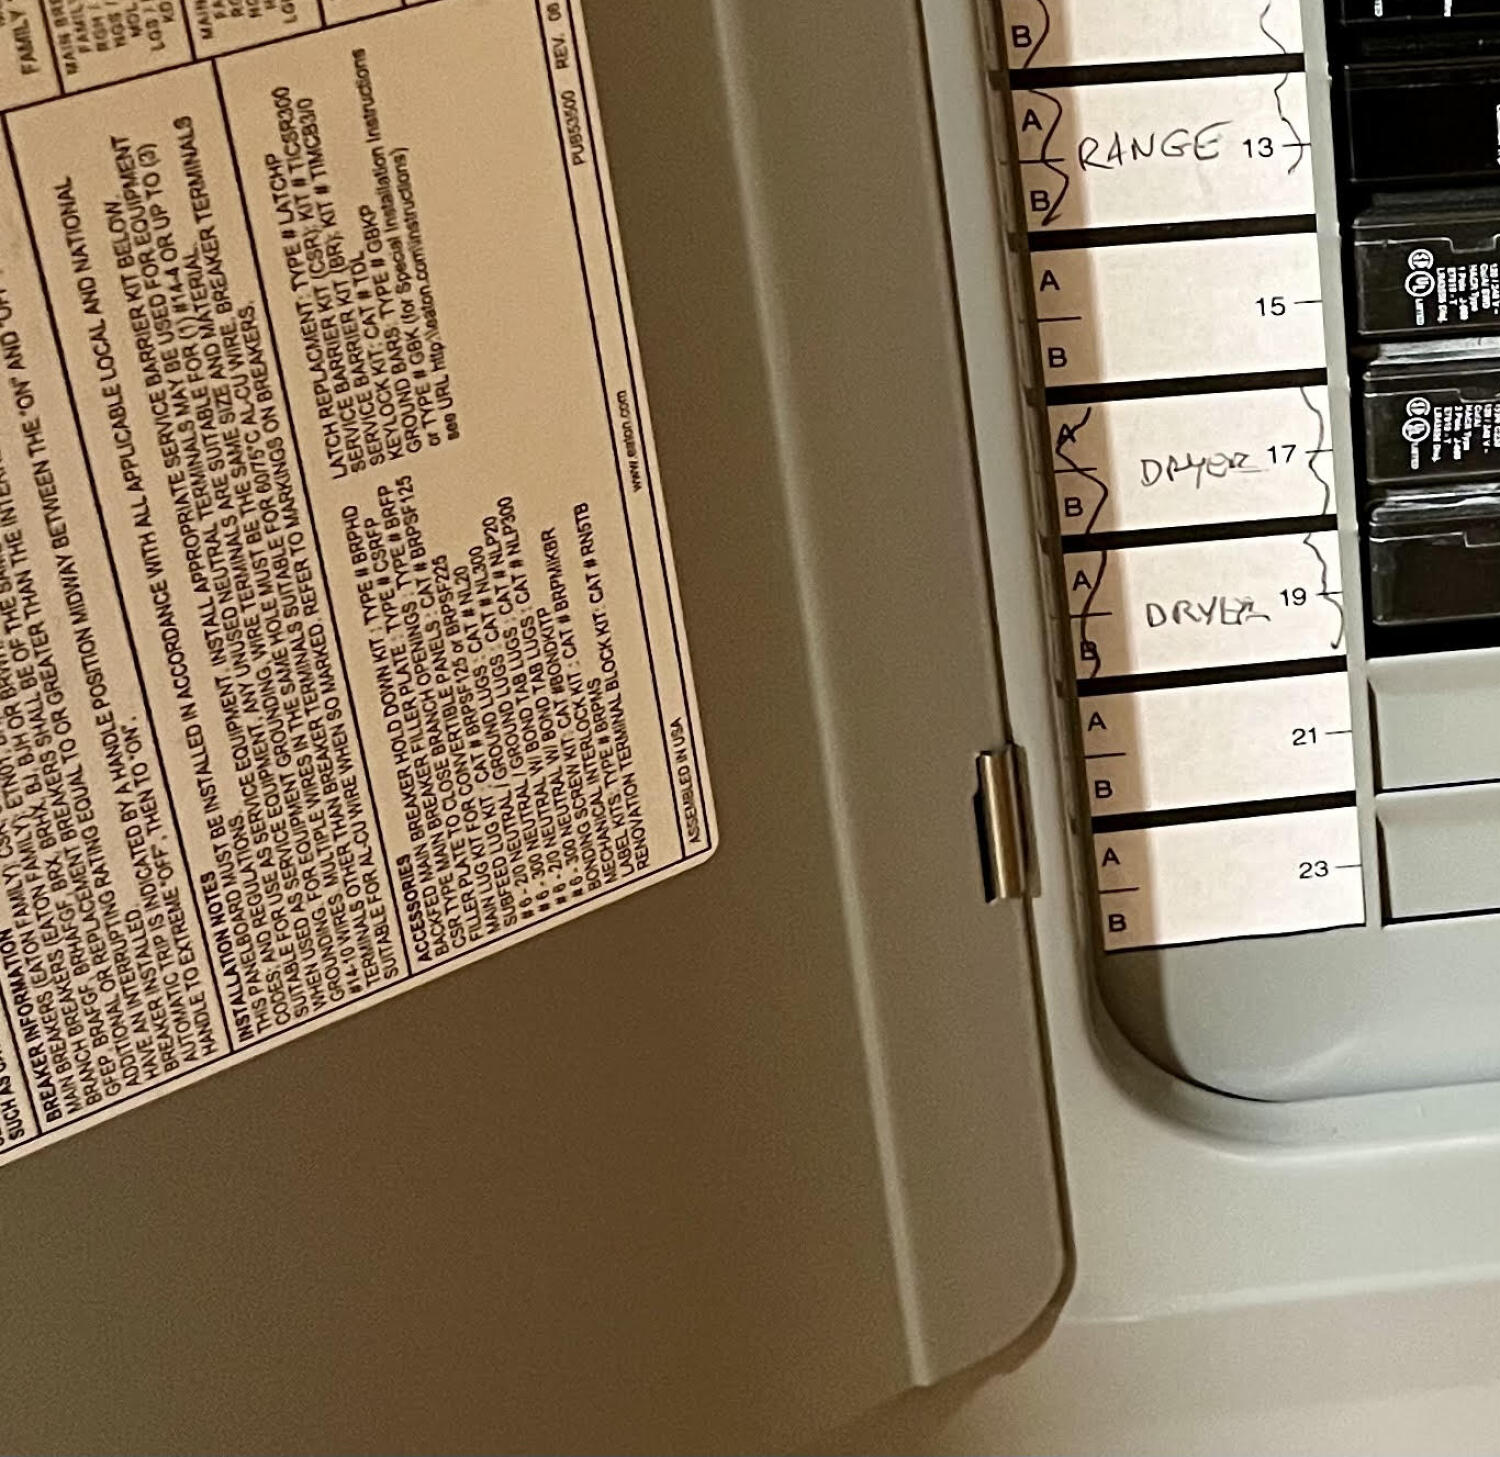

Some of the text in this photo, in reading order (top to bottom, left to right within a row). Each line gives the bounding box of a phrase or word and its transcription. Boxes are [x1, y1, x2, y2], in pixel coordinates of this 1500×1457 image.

[1011, 25, 1032, 47] B
[1022, 109, 1042, 132] A
[1079, 122, 1231, 170] RANGE
[1243, 137, 1273, 158] 13
[264, 152, 294, 225] LATCHP
[1031, 191, 1050, 211] B
[282, 242, 308, 292] TYPE
[1040, 270, 1060, 291] A
[1256, 297, 1285, 316] 15
[1048, 347, 1067, 368] B
[1057, 424, 1078, 446] A
[321, 420, 348, 480] LATCH
[1268, 445, 1296, 463] 17
[1064, 497, 1083, 517] B
[585, 572, 604, 604] CAT
[1073, 570, 1091, 591] A
[1280, 588, 1306, 606] 19
[1081, 641, 1097, 660] B
[597, 636, 619, 691] BLOCK
[607, 692, 632, 770] TERMINAL
[1088, 712, 1106, 731] A
[1292, 728, 1316, 746] 21
[669, 716, 700, 843] ASSEMBLED IN USA
[1095, 780, 1112, 798] B
[621, 771, 649, 870] RENOVATION
[1102, 848, 1120, 867] A
[1300, 861, 1328, 879] 23
[395, 853, 432, 961] ACCESSORIES
[1109, 914, 1126, 932] B
[199, 870, 254, 1042] INSTALLATION NOTES
[0, 927, 62, 1122] BREAKER INFORMATION
